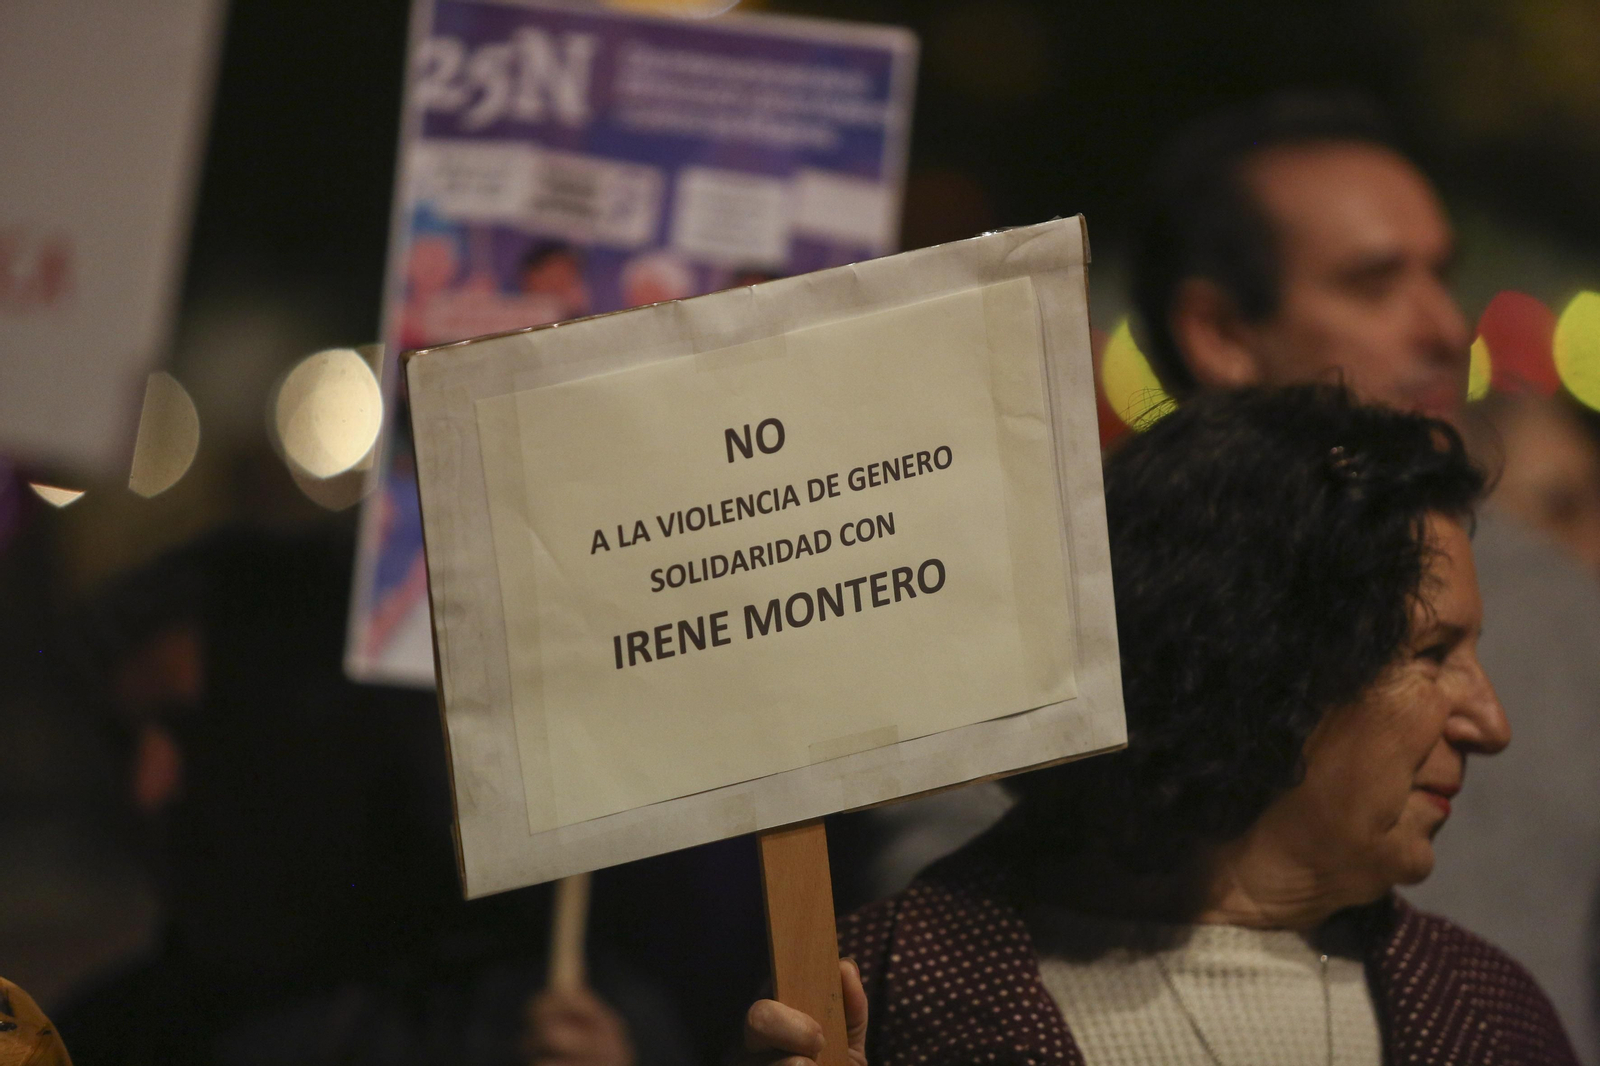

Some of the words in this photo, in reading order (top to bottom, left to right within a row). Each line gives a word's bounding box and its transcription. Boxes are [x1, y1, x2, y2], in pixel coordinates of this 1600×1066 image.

[418, 28, 598, 129] 25N
[724, 417, 786, 464] NO
[590, 529, 611, 555] A
[617, 519, 652, 548] LA
[655, 484, 801, 538] VIOLENCIA
[806, 472, 841, 503] DE
[847, 445, 953, 492] GENERO
[650, 529, 832, 593] SOLIDARIDAD
[839, 511, 896, 547] CON
[613, 610, 732, 670] IRENE
[743, 558, 946, 640] MONTERO
